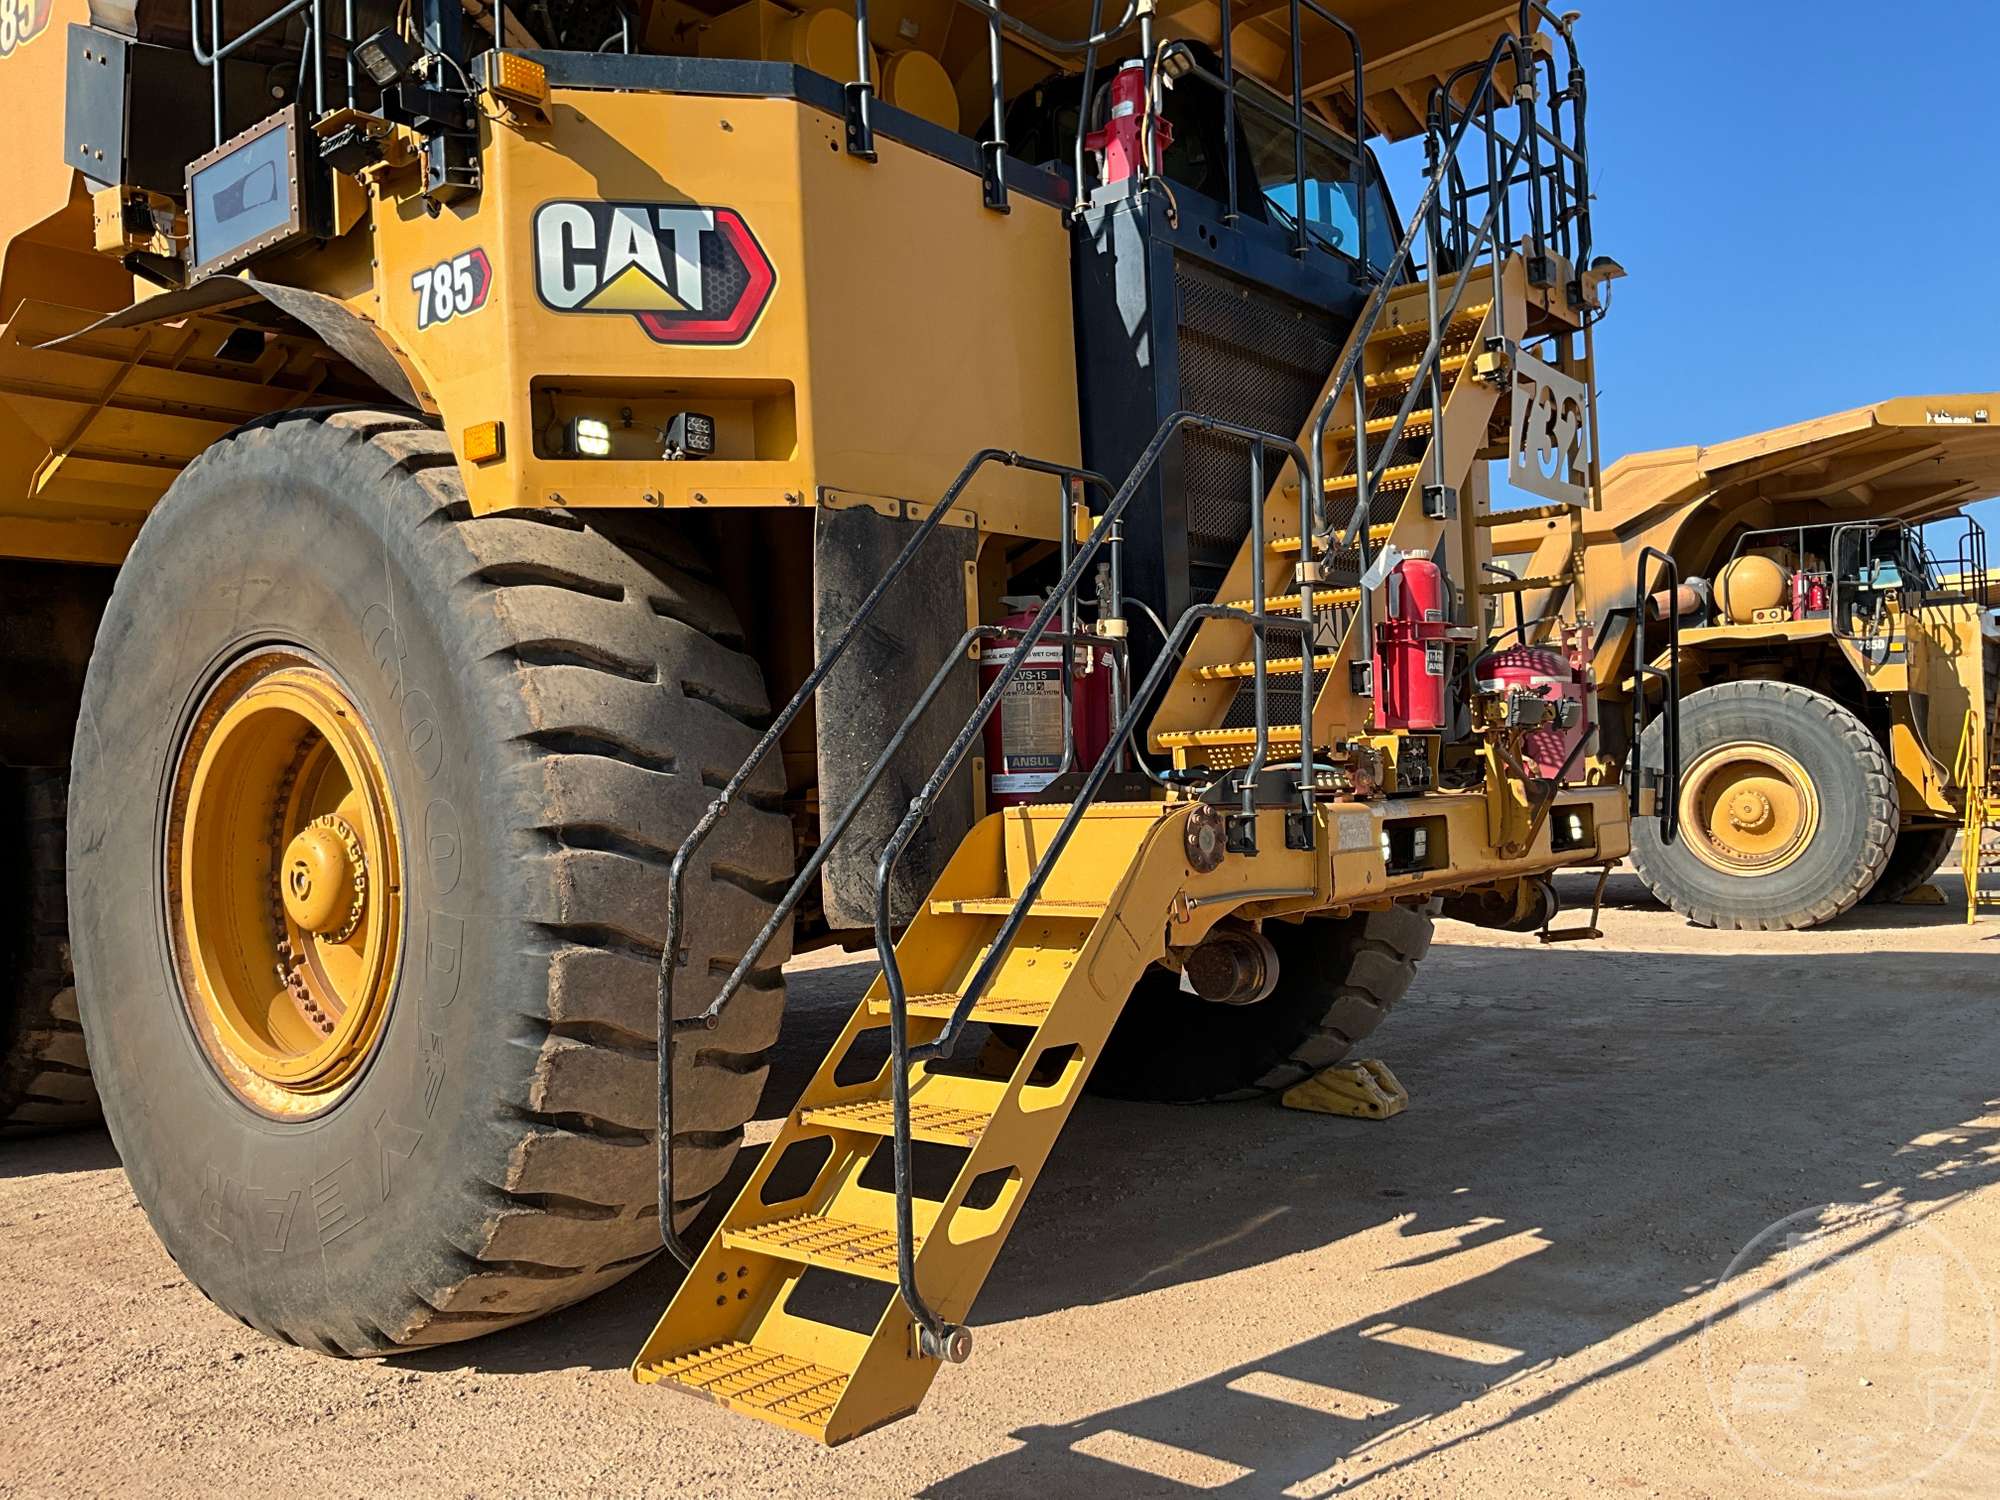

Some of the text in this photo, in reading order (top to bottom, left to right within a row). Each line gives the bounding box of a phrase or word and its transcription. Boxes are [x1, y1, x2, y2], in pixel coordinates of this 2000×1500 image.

[411, 254, 472, 328] 785
[537, 203, 715, 311] CAT
[1516, 369, 1585, 488] 732
[1012, 756, 1055, 767] ANSUL
